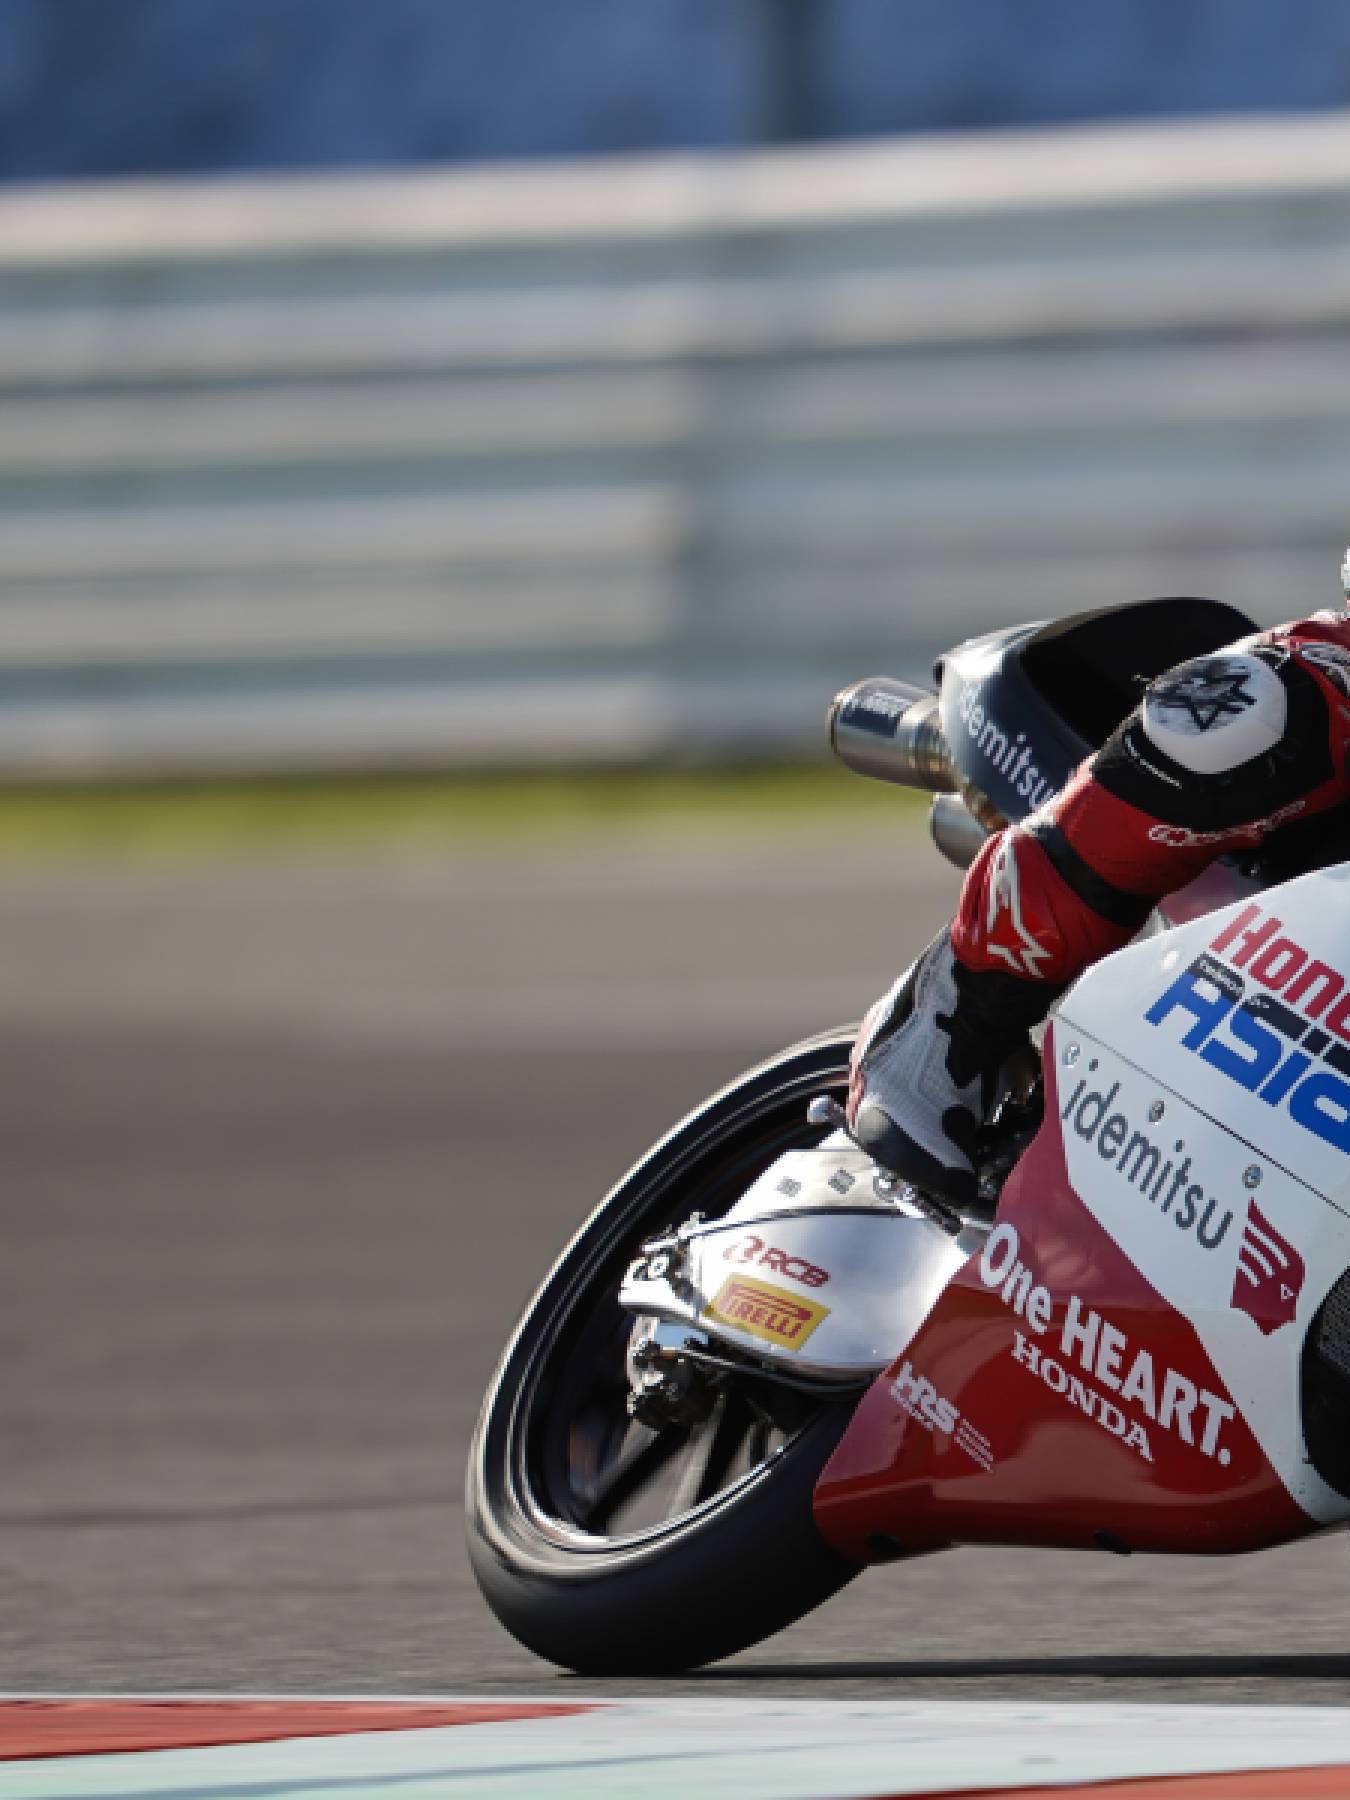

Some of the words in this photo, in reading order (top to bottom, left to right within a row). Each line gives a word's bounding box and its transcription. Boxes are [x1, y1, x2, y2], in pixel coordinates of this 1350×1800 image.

[960, 682, 1055, 808] demitsu
[1060, 1057, 1234, 1250] idemitsu
[715, 1282, 813, 1339] PIRELLI
[979, 1221, 1052, 1336] One
[1060, 1295, 1238, 1467] HEART.
[1010, 1328, 1156, 1463] HONDA
